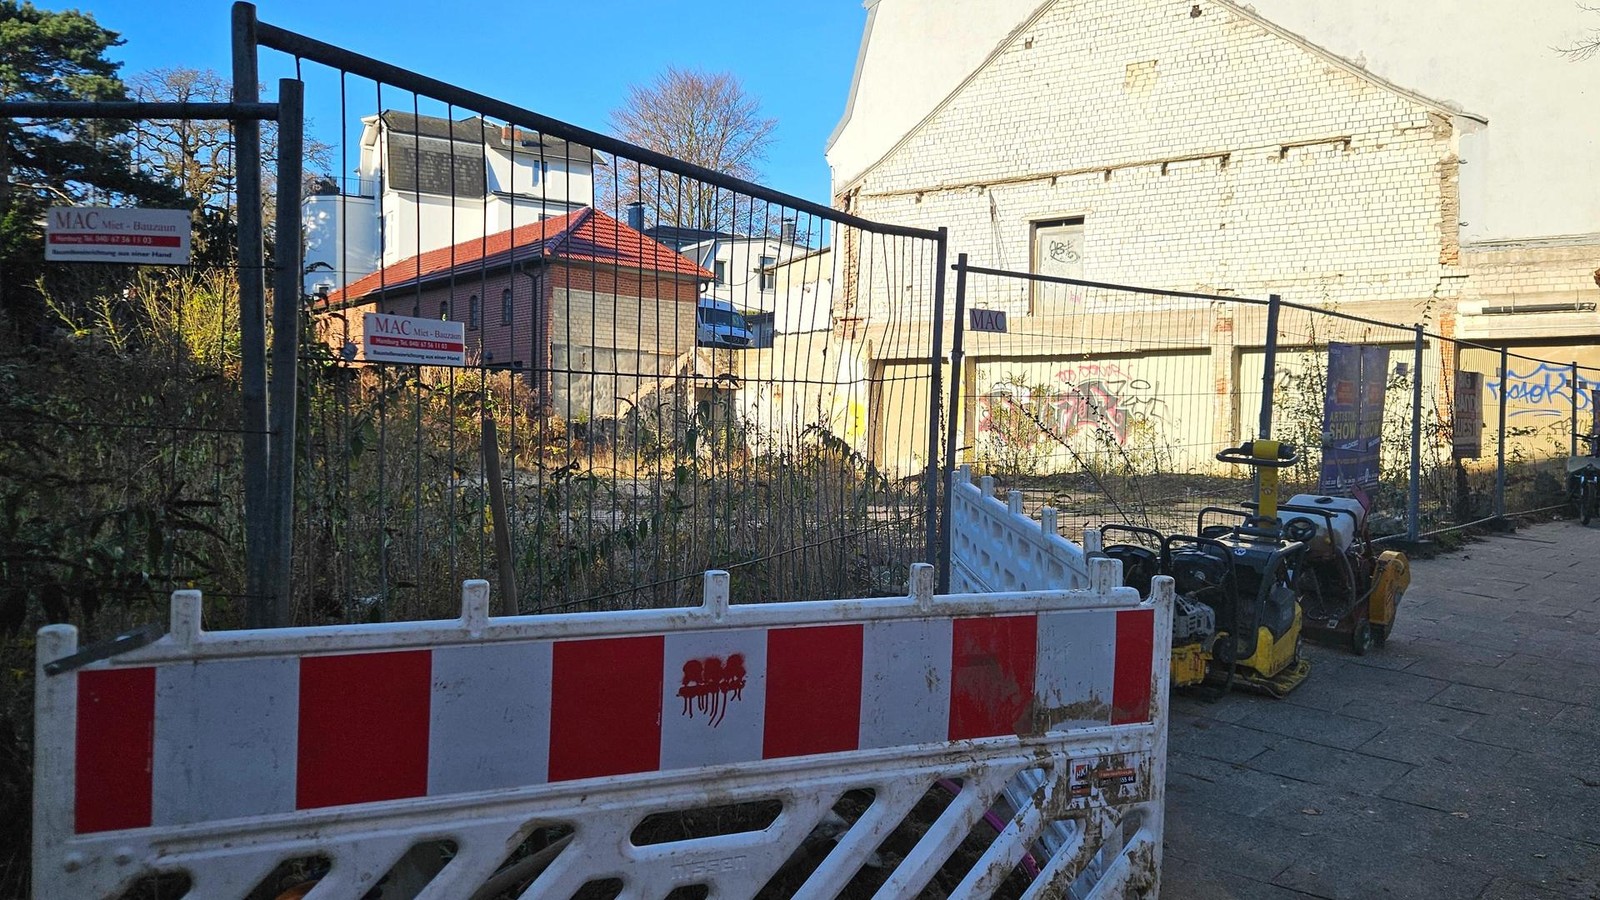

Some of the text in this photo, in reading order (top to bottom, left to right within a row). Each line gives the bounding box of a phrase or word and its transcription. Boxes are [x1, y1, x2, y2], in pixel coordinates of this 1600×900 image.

[56, 211, 99, 230] MAC
[102, 220, 124, 230] Miet
[133, 221, 176, 232] Bauzaun
[375, 317, 411, 335] MAC
[413, 328, 429, 337] Miet
[434, 330, 462, 340] Bauzaun
[972, 310, 1004, 331] MAC
[1329, 421, 1357, 440] SHOW
